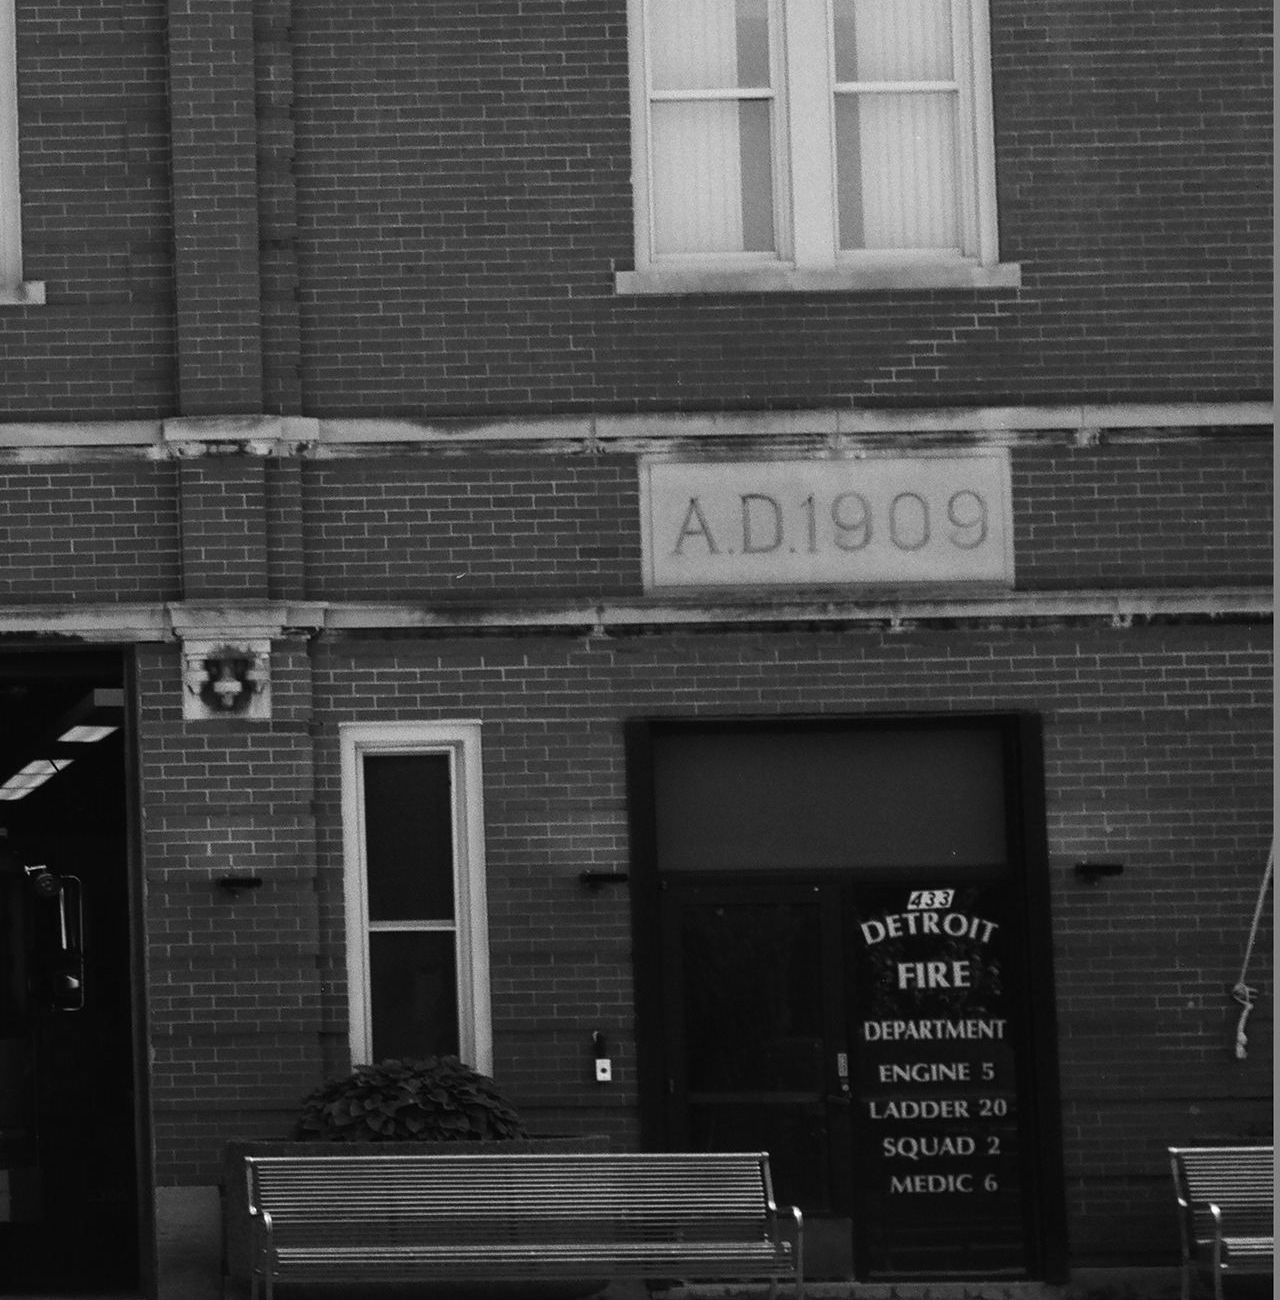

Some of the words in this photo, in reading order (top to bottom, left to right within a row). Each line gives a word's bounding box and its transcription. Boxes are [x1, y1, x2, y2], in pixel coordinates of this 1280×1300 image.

[909, 890, 952, 908] 433
[860, 911, 999, 945] DETROIT
[897, 960, 971, 989] FIRE
[863, 1019, 1007, 1041] DEPARTMENT
[878, 1062, 971, 1083] ENGINE
[981, 1062, 995, 1081] 5
[869, 1099, 970, 1119] LADDER
[979, 1099, 1007, 1117] 20
[882, 1136, 976, 1161] SQUAD
[986, 1136, 1001, 1154] 2
[890, 1174, 973, 1194] MEDIC
[984, 1173, 999, 1192] 6
